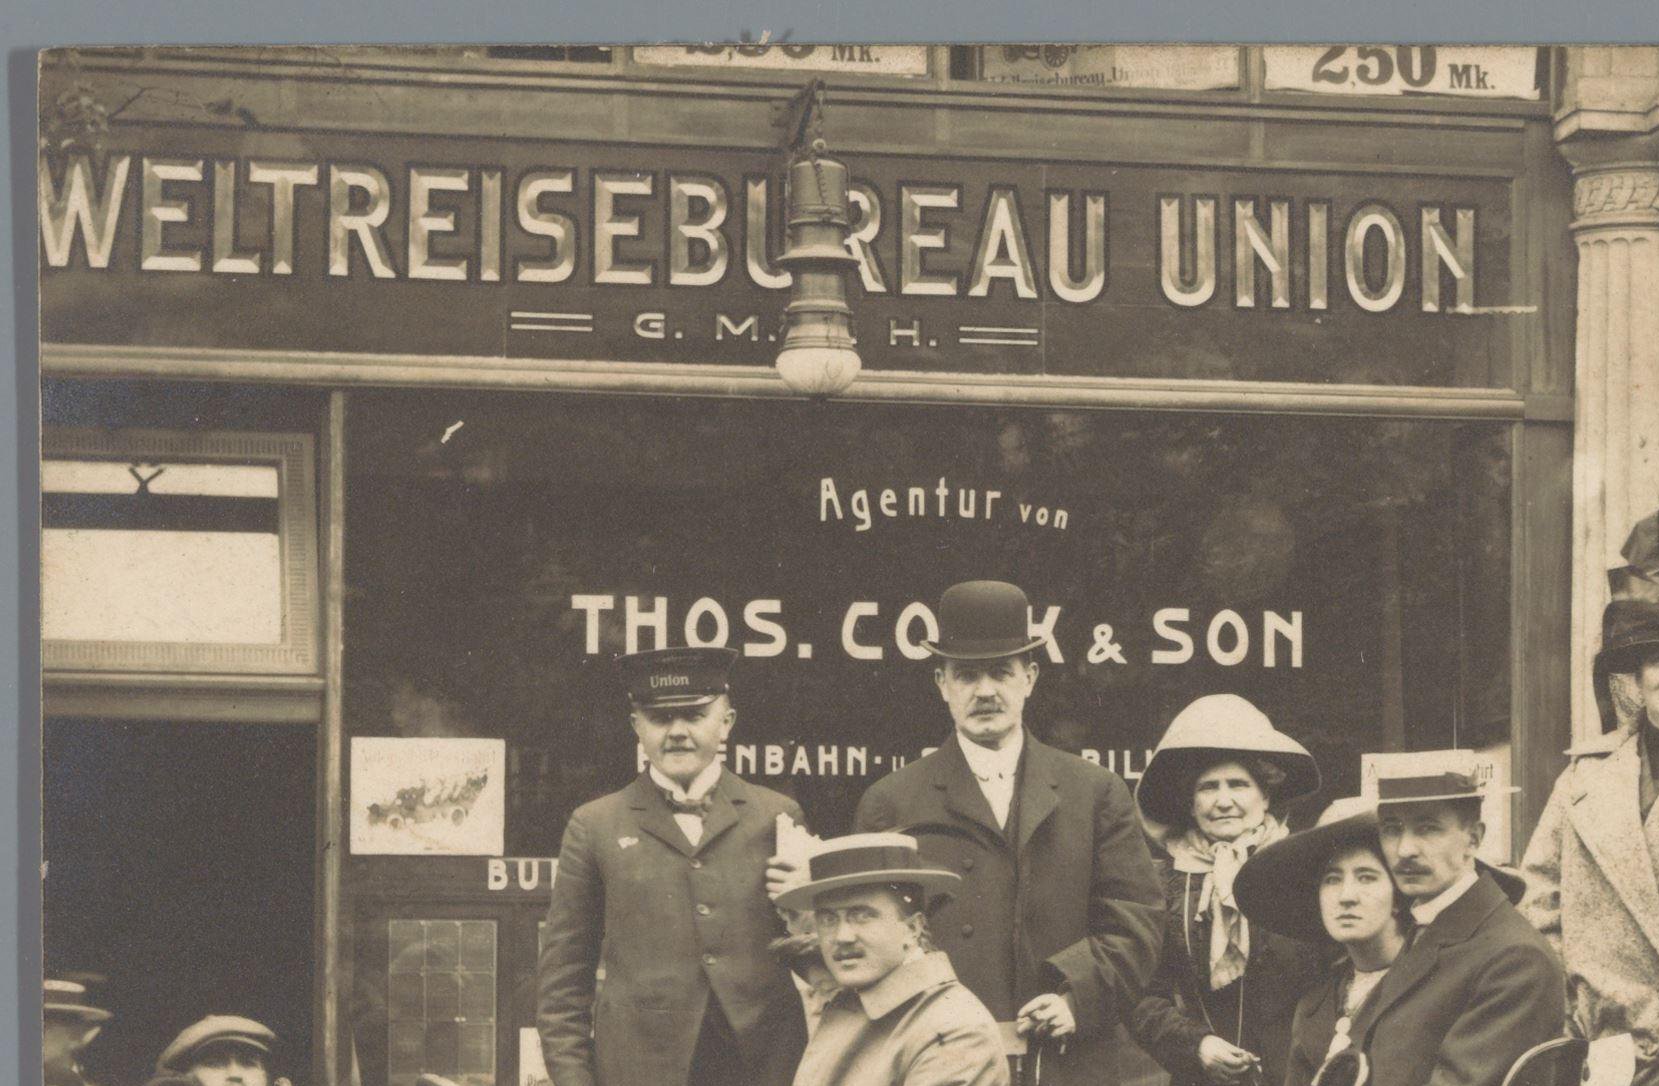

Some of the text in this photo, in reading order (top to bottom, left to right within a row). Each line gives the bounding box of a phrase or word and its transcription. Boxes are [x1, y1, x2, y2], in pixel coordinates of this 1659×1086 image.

[1448, 63, 1496, 90] Mk.
[1160, 199, 1476, 314] UNION
[820, 477, 1069, 532] Agentur von
[571, 594, 1303, 668] THOS. COK & SON
[649, 674, 690, 689] Union
